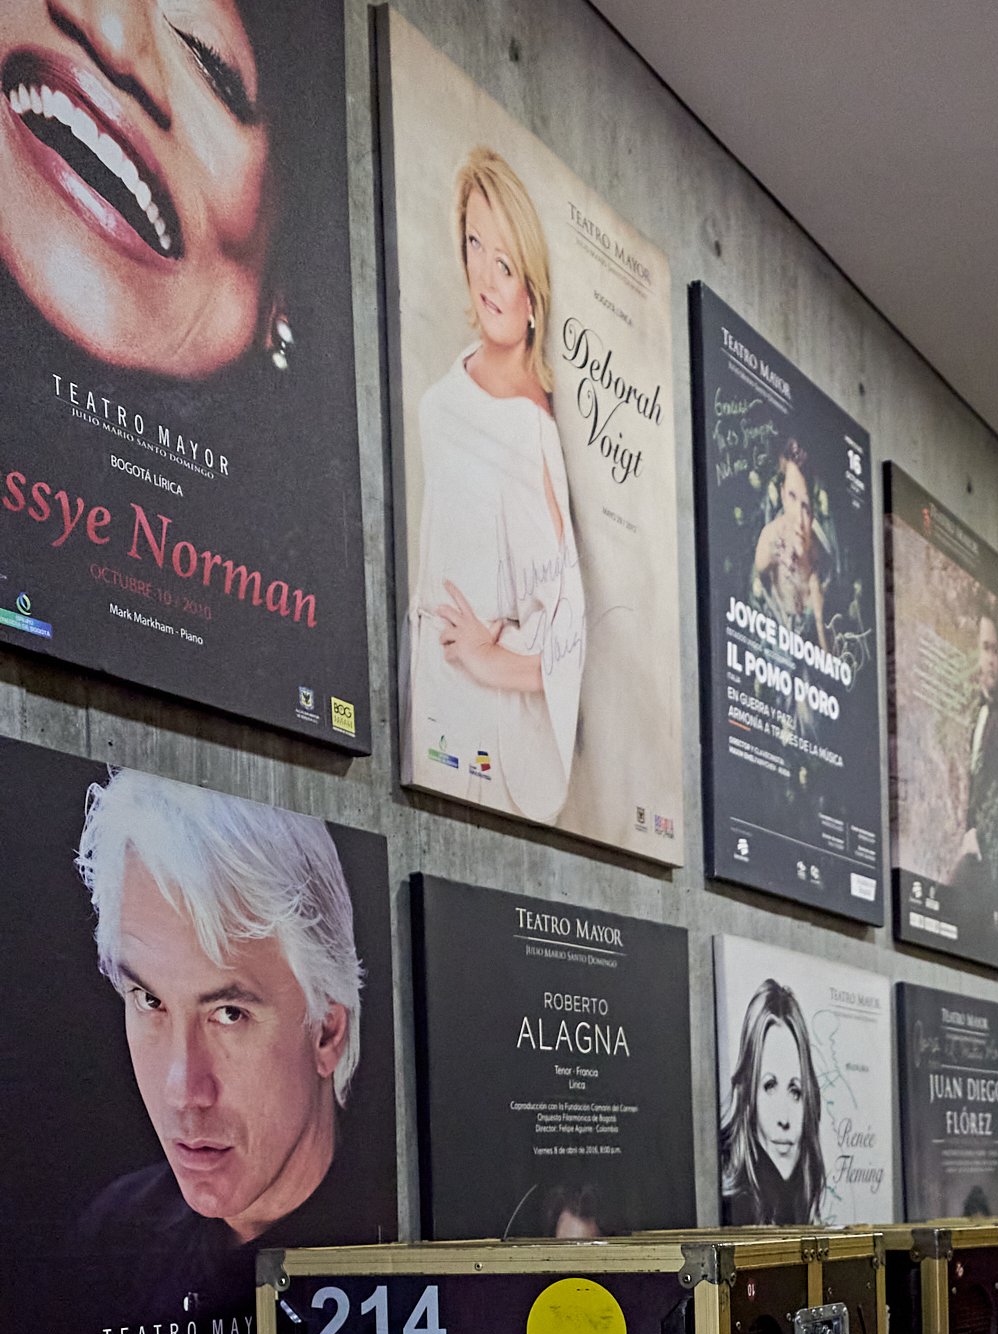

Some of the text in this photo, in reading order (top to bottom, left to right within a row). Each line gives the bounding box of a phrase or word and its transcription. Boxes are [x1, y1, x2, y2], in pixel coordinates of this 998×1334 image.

[567, 200, 611, 250] TEATRO
[561, 317, 664, 426] Deborah
[721, 326, 757, 370] TEATRO
[759, 359, 792, 401] MAYOR
[52, 373, 229, 476] TEATRO MAYOR
[71, 407, 215, 480] JULIO MARIO SANTO DOMINGO
[577, 377, 643, 484] Voigt
[110, 454, 184, 497] BOGOTÁ LÍRICA
[89, 563, 152, 598] OCTUBRE
[127, 502, 318, 629] Norman
[109, 602, 133, 622] Mark
[133, 611, 174, 635] Markham
[180, 628, 204, 646] Piano
[726, 596, 777, 645] JOYCE
[778, 625, 852, 686] DIDONATO
[726, 641, 743, 673] IL
[745, 650, 793, 696] POMO
[794, 676, 840, 720] D'ORO
[727, 686, 740, 701] EN
[739, 692, 771, 718] GUERRA
[728, 705, 764, 731] ARMONÍA
[515, 907, 624, 947] TEATRO MAYOR
[525, 944, 618, 968] JULIO MARIO SANTO DOMINGO
[543, 991, 609, 1016] ROBERTO
[516, 1016, 630, 1057] ALAGNA
[554, 1064, 599, 1077] Tenor Francia
[928, 1073, 963, 1104] JUAN
[836, 1117, 876, 1149] Renée
[945, 1105, 993, 1136] FLÓREZ
[832, 1155, 885, 1194] Fleming
